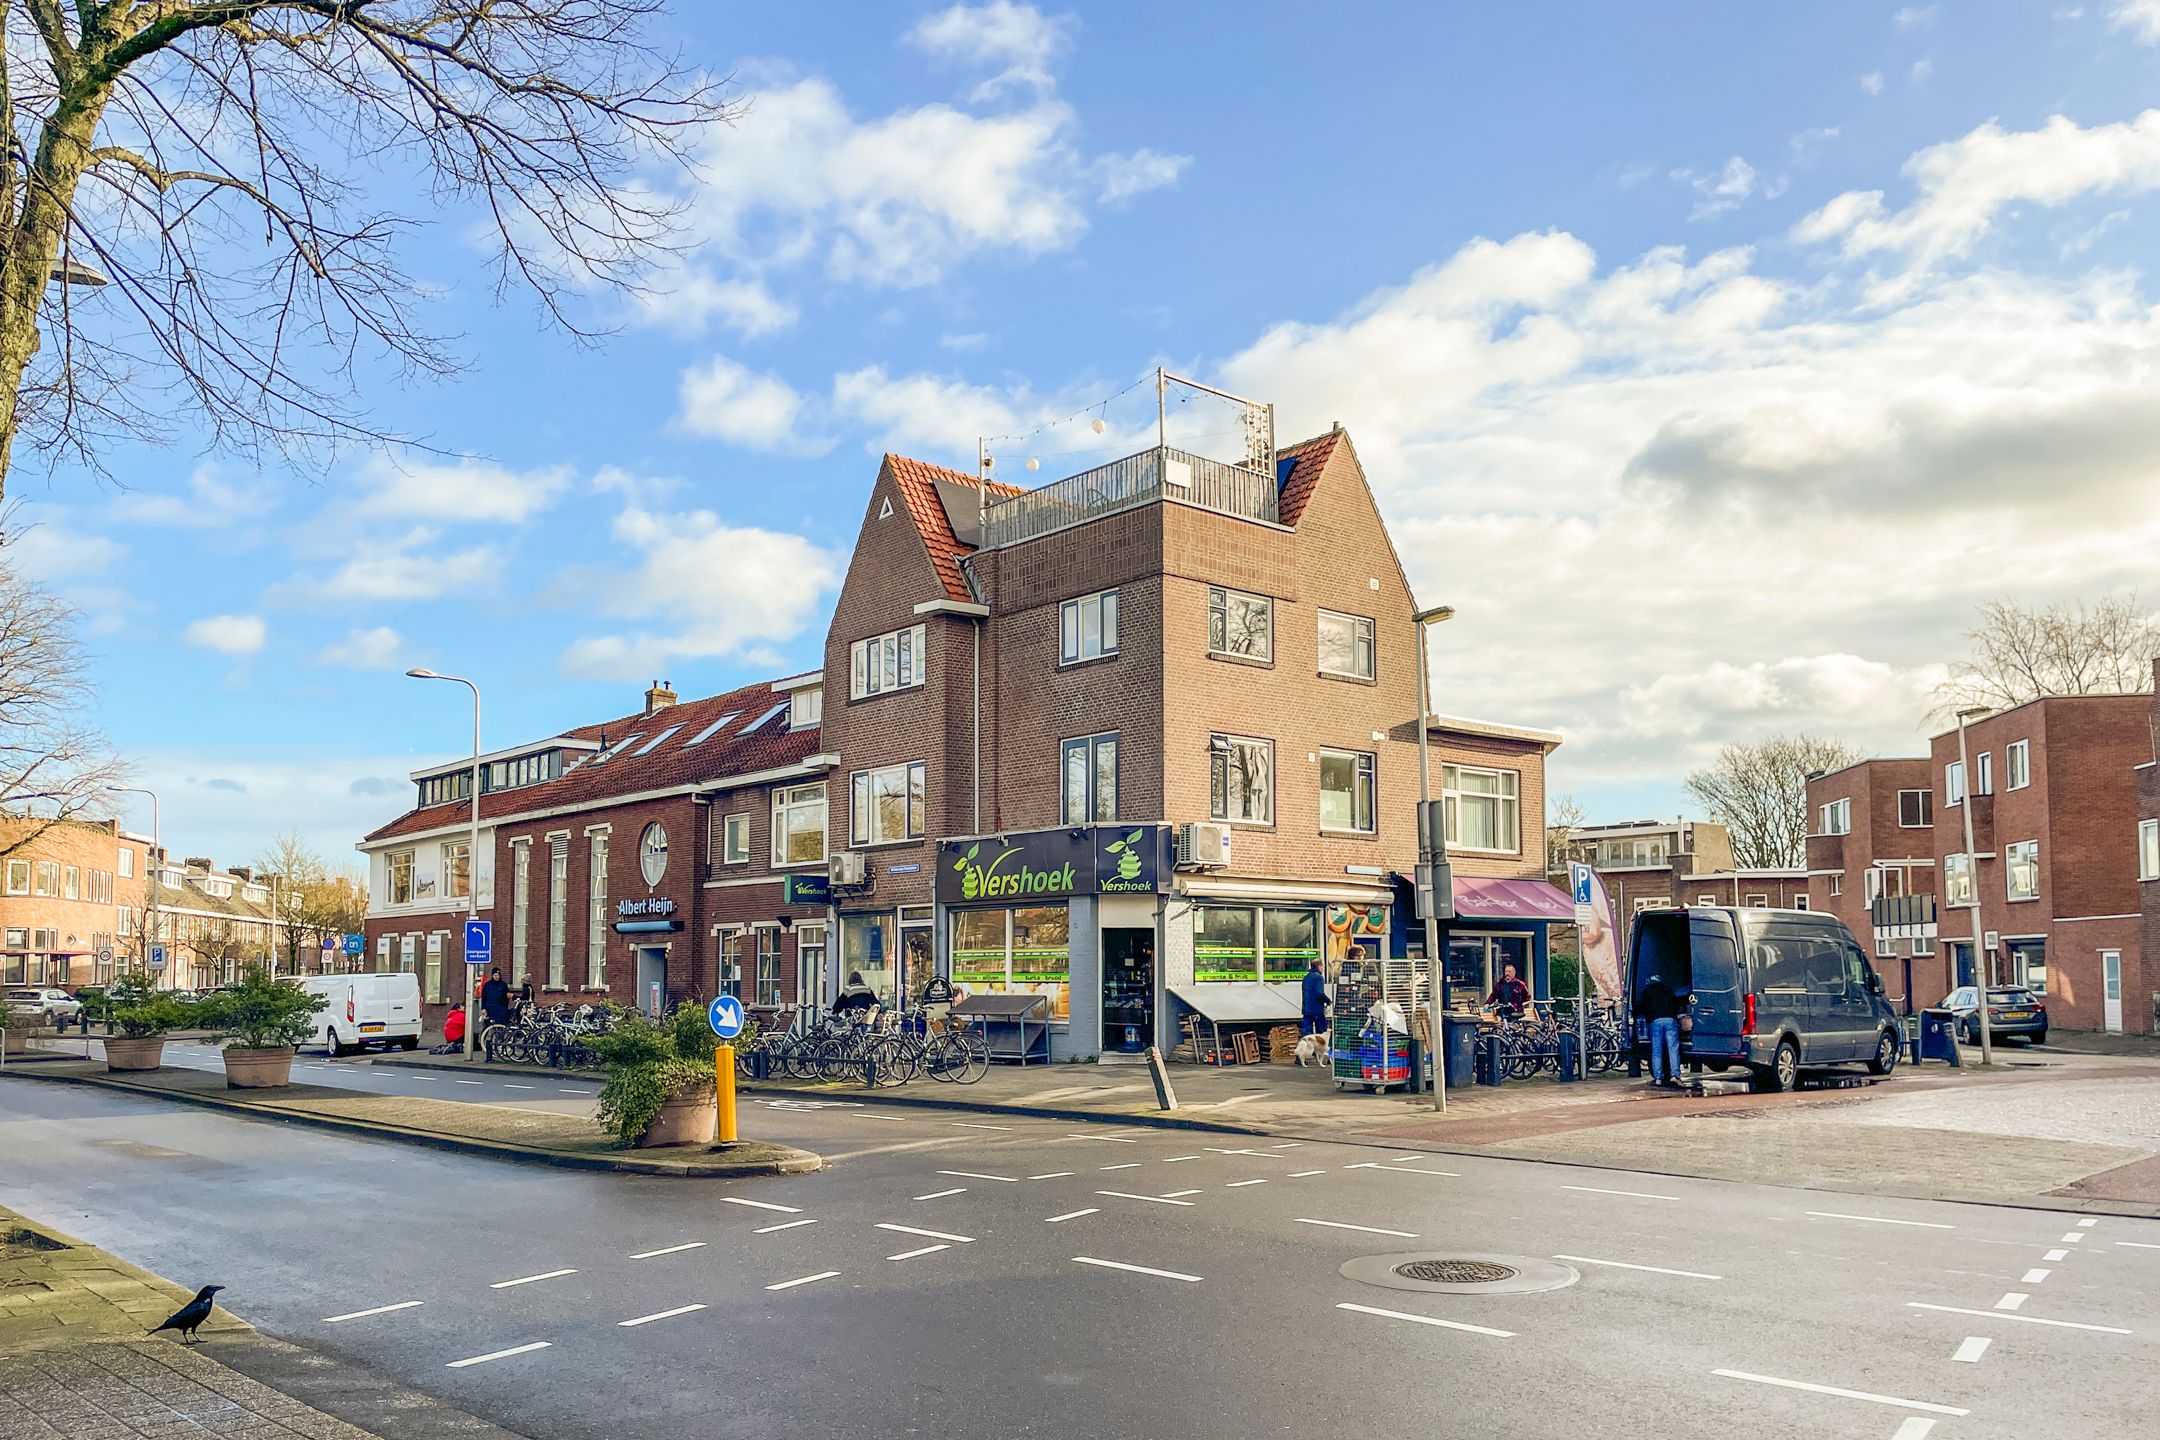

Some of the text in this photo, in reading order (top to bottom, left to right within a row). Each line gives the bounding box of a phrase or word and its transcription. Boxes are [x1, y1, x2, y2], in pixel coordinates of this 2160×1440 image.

[976, 847, 1076, 898] Vershoek
[1578, 867, 1588, 888] P
[1100, 876, 1152, 891] Vershoek
[618, 896, 673, 916] Albert Heijn
